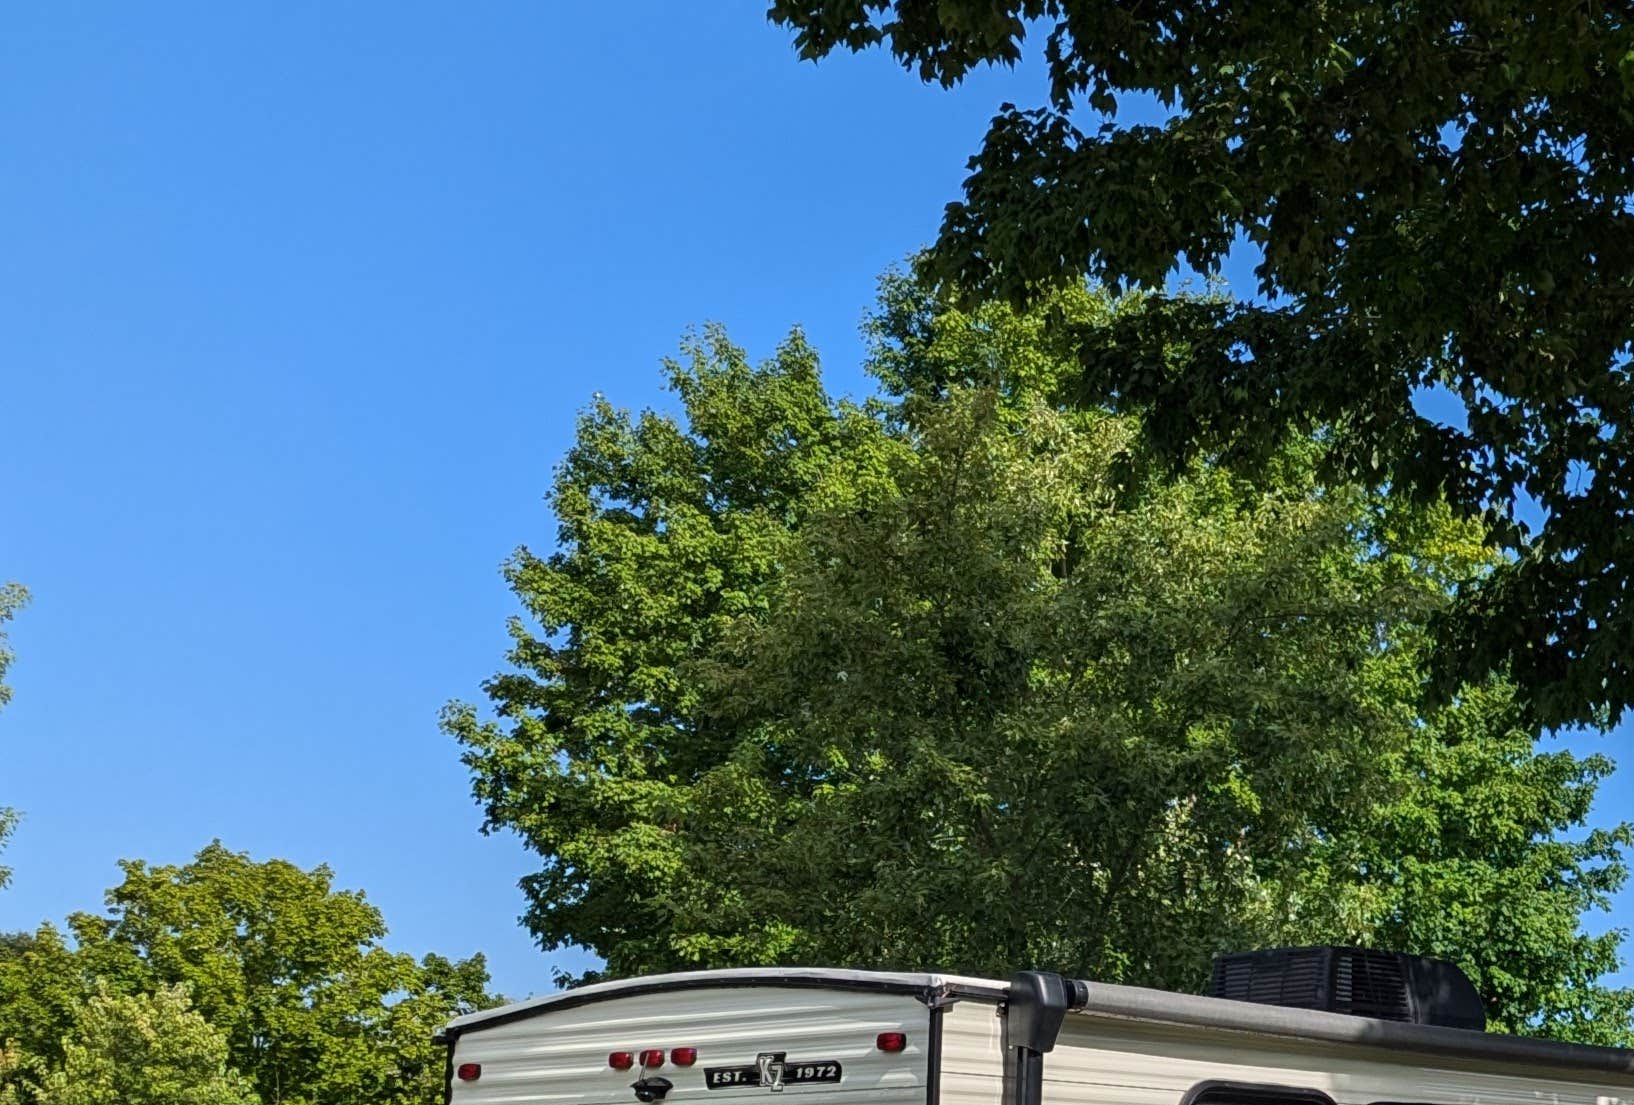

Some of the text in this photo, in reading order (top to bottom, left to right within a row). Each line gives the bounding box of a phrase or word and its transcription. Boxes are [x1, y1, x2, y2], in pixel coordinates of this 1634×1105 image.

[713, 1055, 837, 1092] EST. KZ 1972
